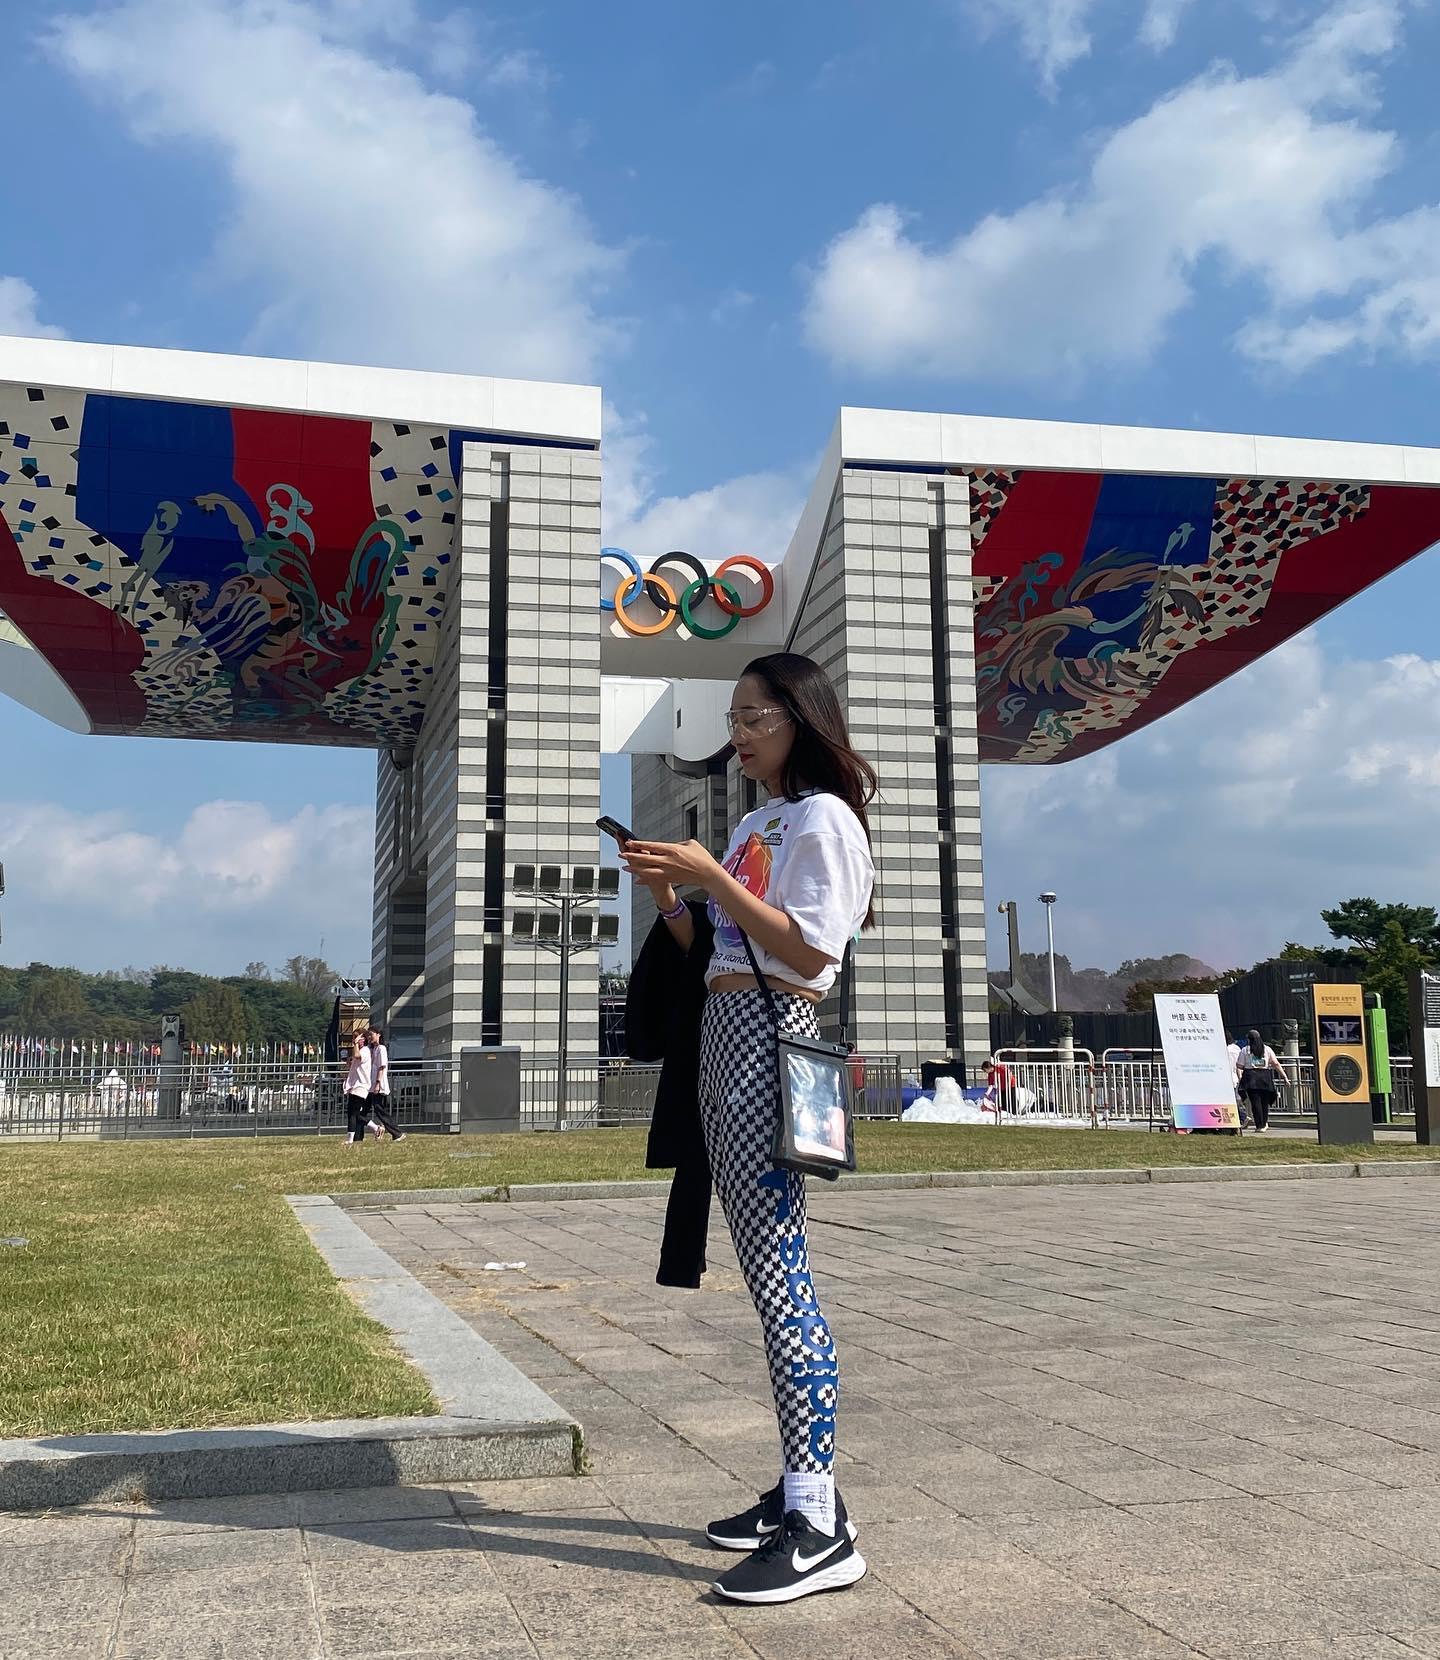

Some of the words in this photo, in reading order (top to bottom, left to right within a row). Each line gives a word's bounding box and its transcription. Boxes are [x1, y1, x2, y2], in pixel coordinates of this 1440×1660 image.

[1171, 1013, 1185, 1021] 버블
[1187, 1013, 1208, 1021] 포토존
[778, 1235, 839, 1463] adidas
